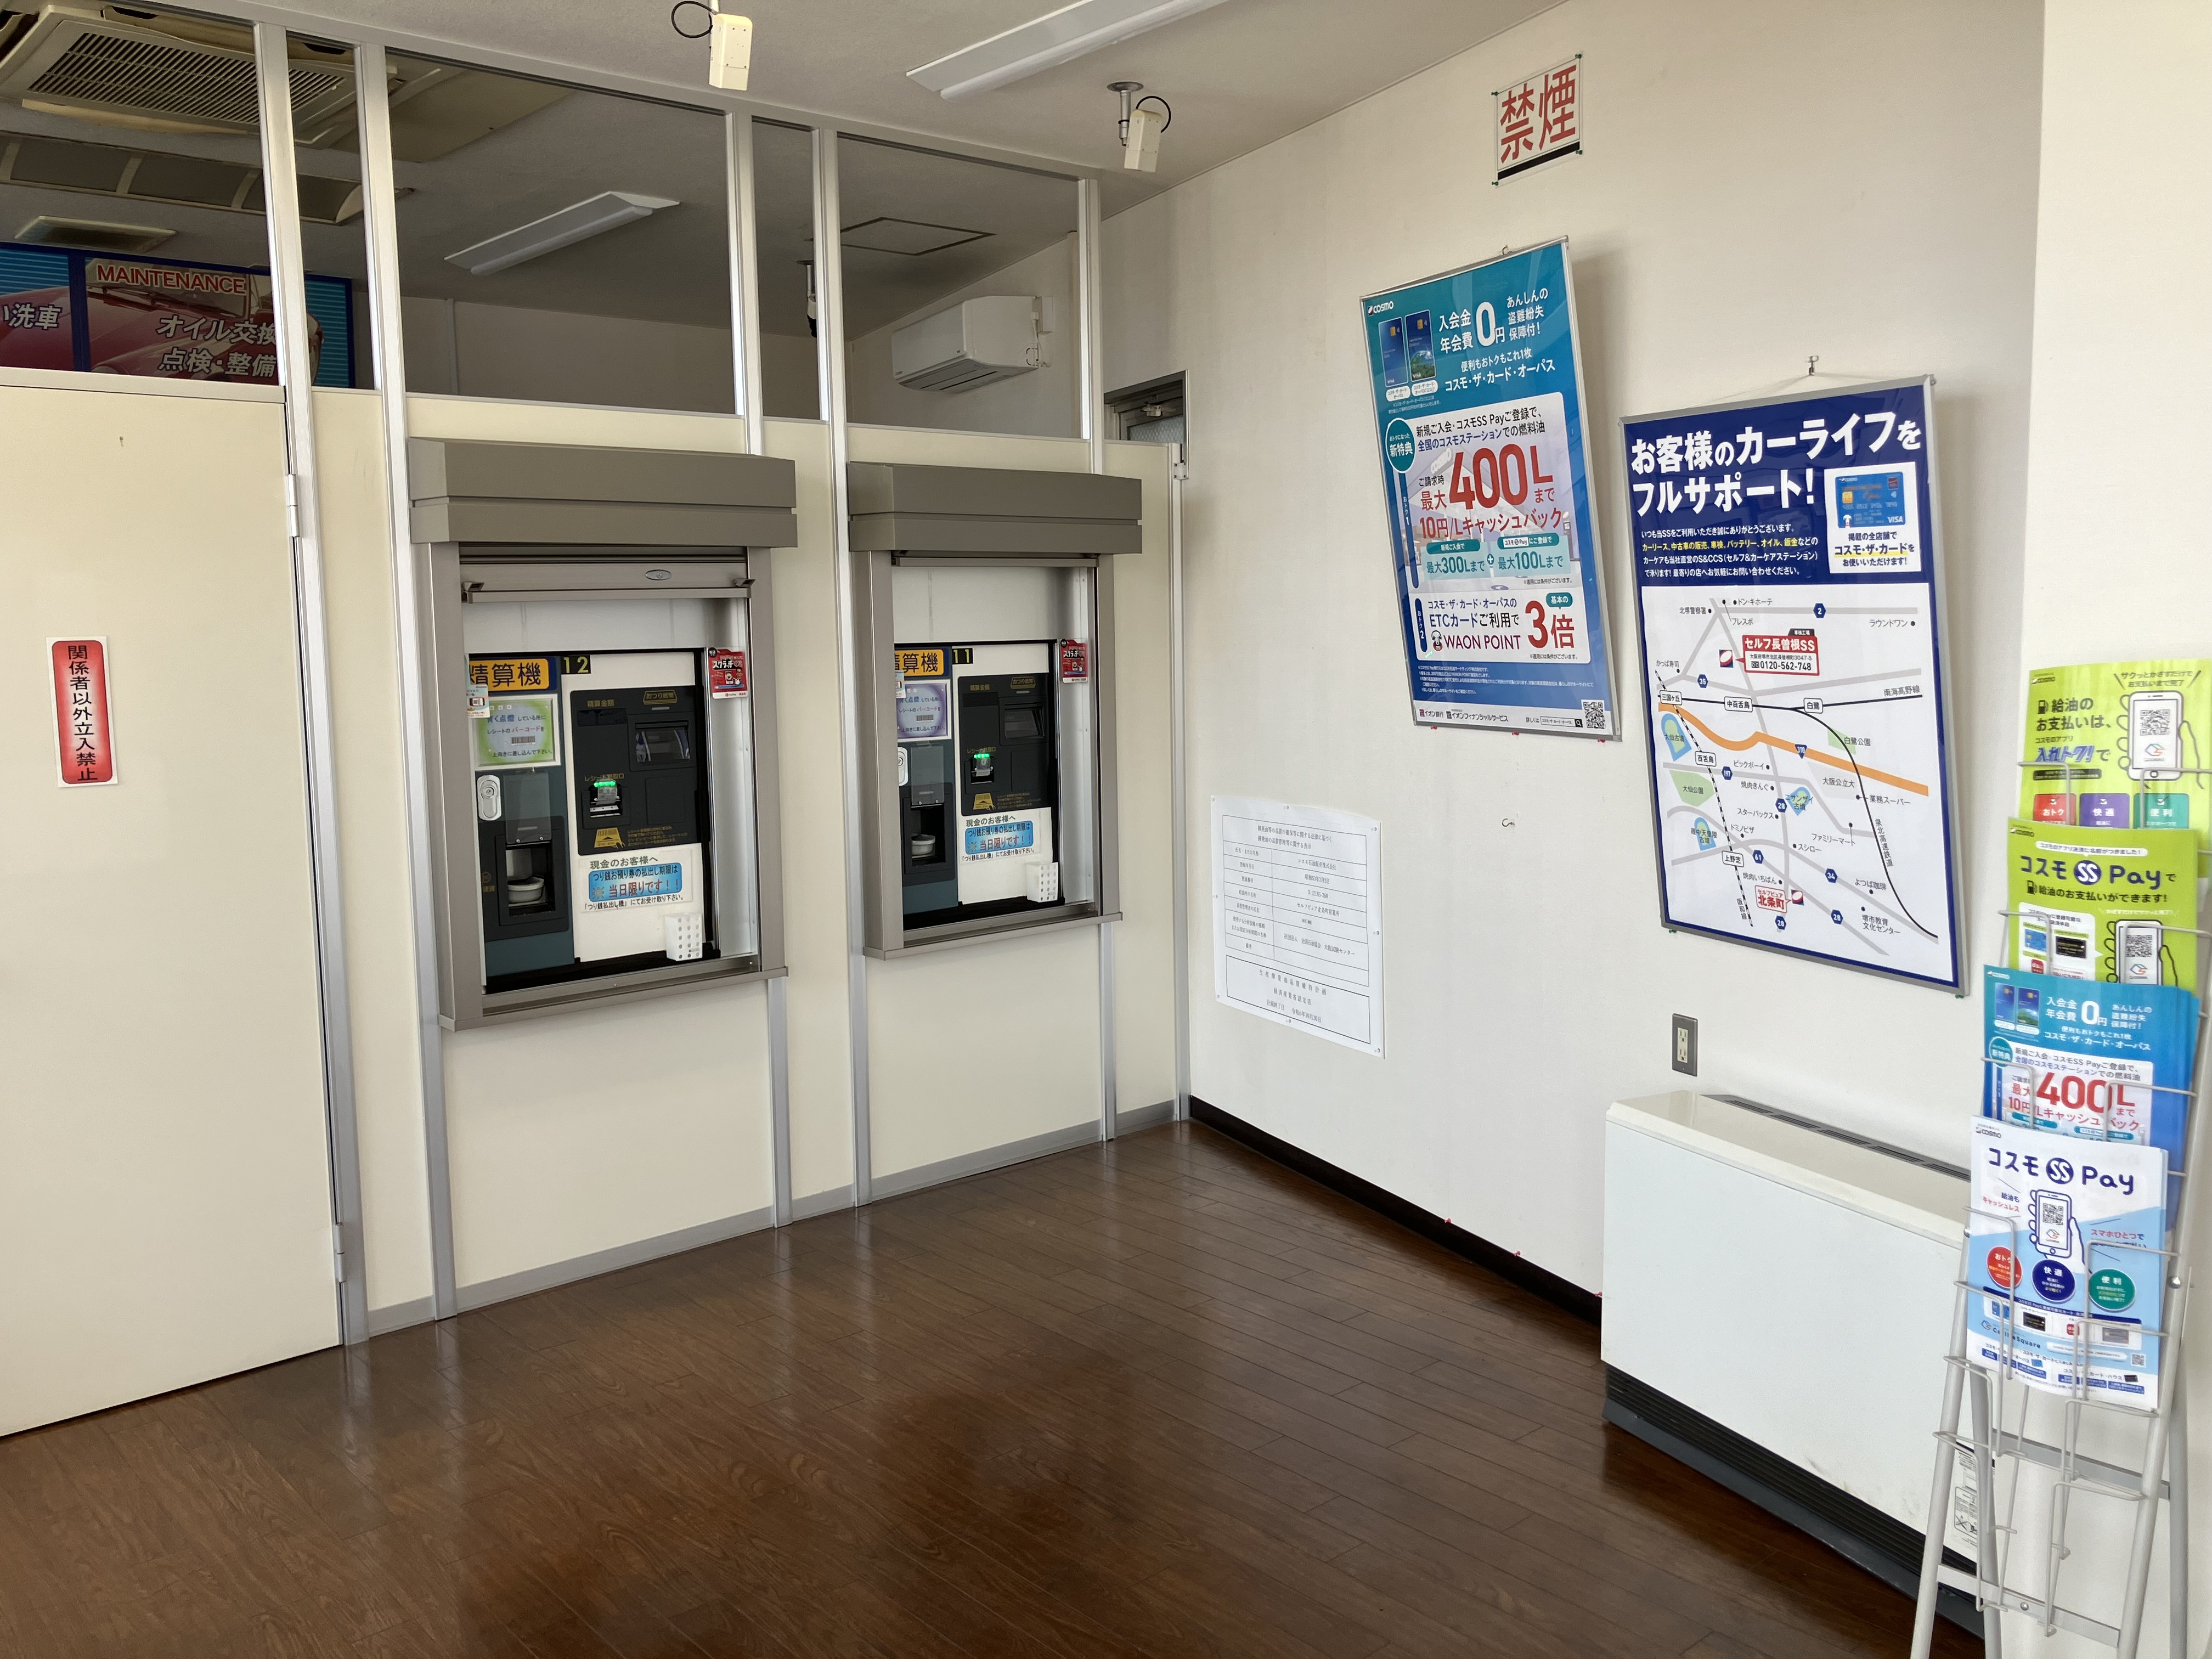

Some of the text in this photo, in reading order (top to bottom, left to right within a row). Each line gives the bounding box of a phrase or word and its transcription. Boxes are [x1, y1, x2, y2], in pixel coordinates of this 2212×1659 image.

[1500, 64, 1576, 164] 禁煙
[97, 264, 247, 295] MAINTENANCE
[1506, 287, 1548, 308] あんしんの
[1373, 301, 1393, 314] COSMO
[1508, 304, 1544, 325] 盗難紛失
[1438, 308, 1471, 332] 入会金
[156, 314, 276, 346] オイル交換
[1509, 327, 1541, 341] 保障付!
[1440, 331, 1473, 354] 年会費
[158, 347, 276, 377] 点検・整備
[1461, 347, 1532, 373] 便利もおトクもこれ1枚
[1444, 358, 1555, 392] コスモ・ザ・カード・オーパス
[1418, 421, 1545, 452] 全国のコスモステーションでの燃料油
[1630, 411, 1921, 475] お客様のカーライフを
[1390, 442, 1413, 458] 新特典
[1418, 475, 1444, 487] ご請求時
[1449, 443, 1553, 510] 400L
[1420, 488, 1447, 511] 最大
[1534, 487, 1555, 503] まで
[1633, 468, 1814, 517] フルサポート!
[1419, 507, 1563, 539] 10円/Lキャッシュバック
[1641, 523, 1794, 538] いつも当SSをご利用いただき誠にありがとうございます。
[1848, 532, 1897, 541] 掲載の全店舗で
[1835, 543, 1914, 555] コスモ・ザ・カードを
[1426, 556, 1485, 574] 最大300Lまで
[1498, 551, 1563, 570] 最大100Lまで
[1842, 557, 1907, 566] お使いいただけます!
[1427, 598, 1517, 609] コスモ・ザ・カード・オーパスの
[1550, 595, 1568, 603] 基本の
[1430, 612, 1519, 628] ETCカードご利用で
[1525, 600, 1575, 648] 3倍
[1869, 619, 1908, 628] ラウンドワン
[1444, 634, 1521, 650] WAON POINT
[953, 649, 969, 663] 11
[563, 656, 588, 673] 12
[1656, 660, 1680, 668] かっぱ寿司
[1760, 661, 1811, 670] 0120-562-748
[1883, 685, 1920, 697] 南海高野線
[1726, 701, 1750, 709] 中百舌鳥
[1807, 702, 1820, 710] 白鷺
[2051, 697, 2093, 713] 給油の
[67, 645, 98, 781] 関係者以外立入禁止
[1452, 712, 1509, 722] イオンフィナンシャルサービス
[2036, 715, 2112, 732] お支払いは、
[1664, 734, 1684, 742] 大仙古墳
[1844, 737, 1871, 746] 白鷺公園
[2035, 735, 2073, 743] コスモのアプリ
[1797, 746, 1805, 754] 310
[1697, 755, 1713, 763] 百舌鳥
[1682, 785, 1703, 794] 大仙公園
[1741, 781, 1768, 791] 焼肉きんぐ
[1822, 777, 1854, 788] 大阪公立大
[1869, 795, 1910, 805] 業務スーパー
[1737, 808, 1774, 819] スターバックス
[2093, 808, 2114, 817] 快適
[966, 815, 1015, 827] 現金のお客様へ
[1811, 833, 1855, 845] ファミリーマート
[1875, 819, 1893, 867] 泉北高速鉄道
[1798, 843, 1821, 851] スシロー
[590, 855, 658, 870] 現金のお客様へ
[1724, 855, 1741, 864] 上野芝
[592, 865, 678, 881] つり銭お預り券の払出し期限は
[2020, 855, 2067, 879] コスモ
[1742, 872, 1776, 884] 焼肉いちばん
[1854, 878, 1886, 890] よつば珈琲
[1758, 889, 1782, 898] セルフピュア
[2038, 885, 2167, 903] 給油のお支払いができます!
[1736, 898, 1747, 920] 阪和線
[1758, 895, 1785, 910] 北条町
[1862, 915, 1888, 926] 堺市教育
[1863, 922, 1900, 935] 文化センター
[2046, 996, 2077, 1009] 入会金
[2112, 1004, 2152, 1013] あんしんの
[2046, 1008, 2076, 1022] 年会費
[2044, 1031, 2151, 1051] コスモ・ザ・カード・オーパス
[2015, 1056, 2140, 1081] 全国のコスモステーションでの燃料油
[2117, 1108, 2135, 1118] まで
[1981, 1128, 2001, 1138] COSMO
[1989, 1147, 2039, 1176] コスモ
[2082, 1166, 2134, 1195] Pay
[1983, 1196, 2020, 1212] キャッシュレス
[2001, 1192, 2019, 1203] 給油も
[2091, 1228, 2144, 1240] スマホひとつで
[2044, 1266, 2062, 1277] 快適
